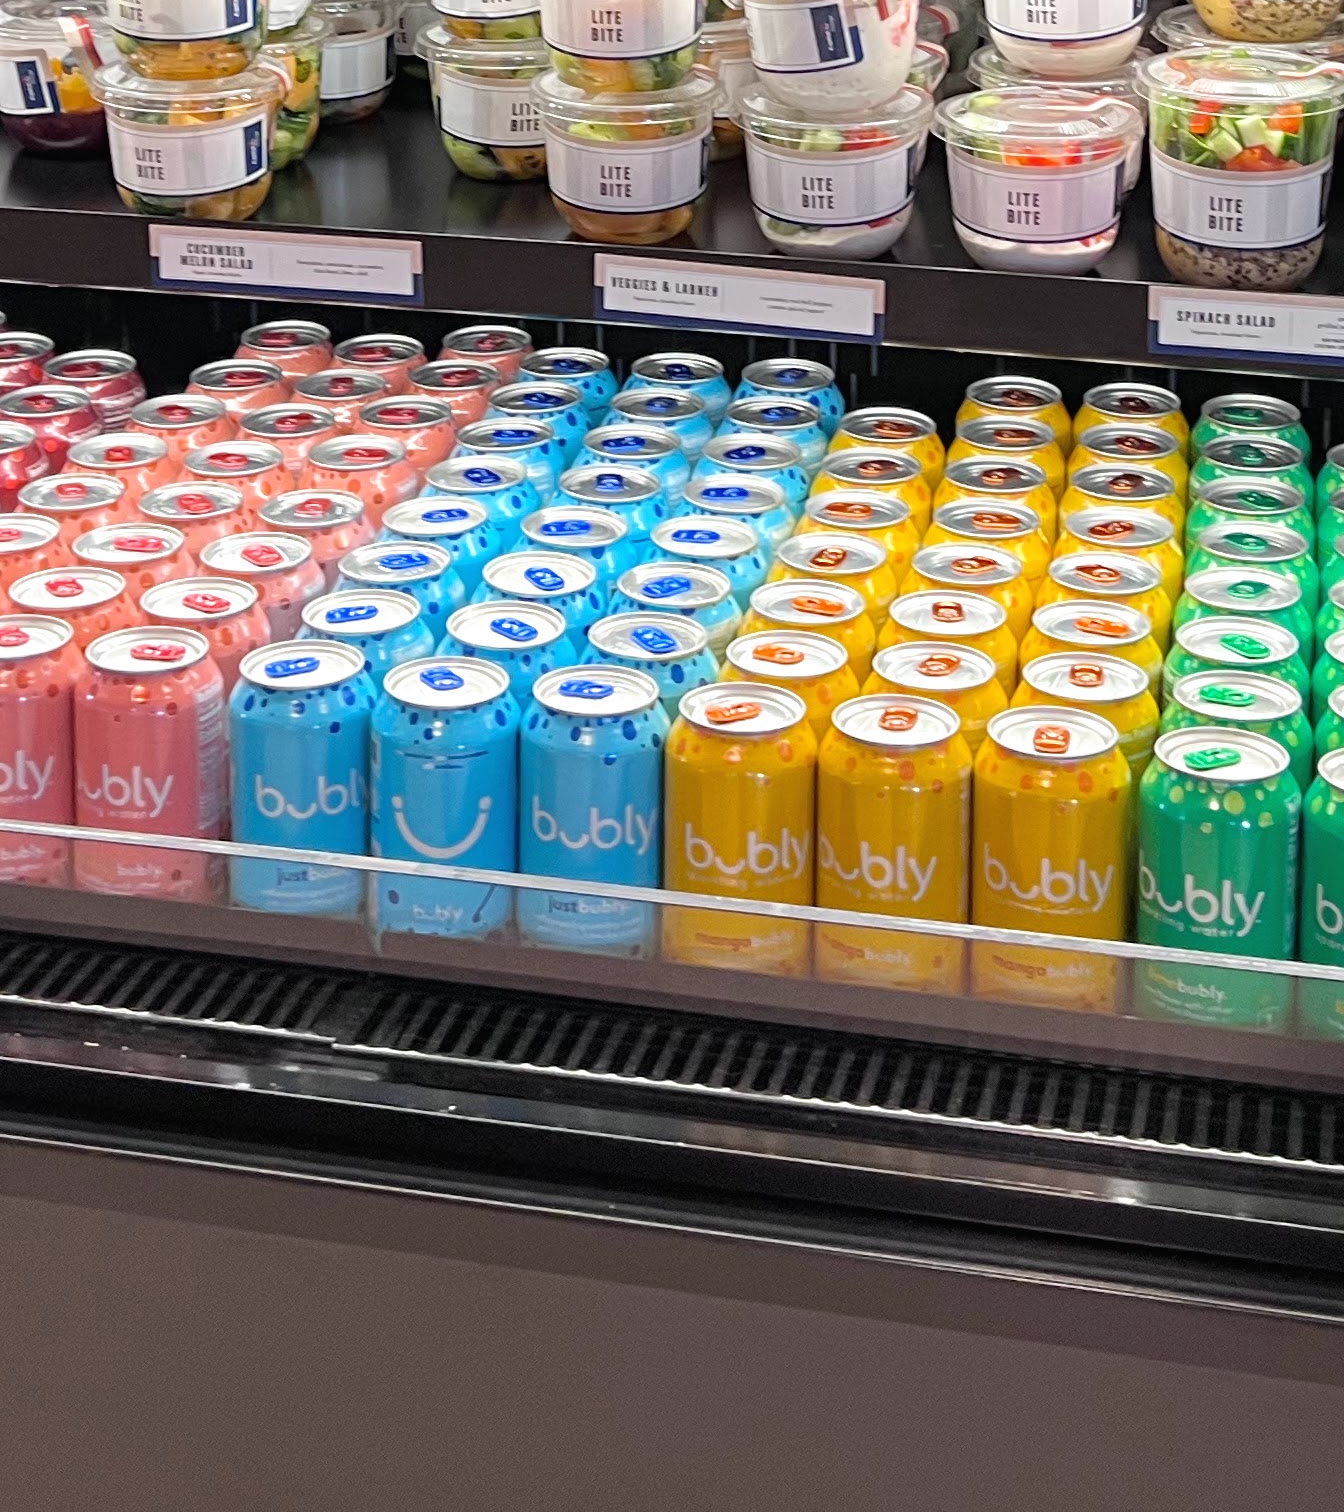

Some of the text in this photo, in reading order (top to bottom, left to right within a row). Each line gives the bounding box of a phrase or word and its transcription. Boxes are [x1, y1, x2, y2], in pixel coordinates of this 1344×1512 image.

[590, 9, 622, 25] LITE
[1026, 9, 1058, 25] BITE
[590, 26, 624, 43] BITE
[510, 118, 540, 132] BITE
[135, 147, 162, 164] LITE
[137, 164, 165, 180] BITE
[600, 165, 631, 181] LITE
[599, 182, 632, 198] BITE
[801, 176, 834, 193] LITE
[801, 193, 835, 210] BITE
[1008, 191, 1040, 208] LITE
[1209, 196, 1243, 214] LITE
[1007, 209, 1041, 226] BITE
[1209, 215, 1244, 233] BITE
[186, 243, 245, 257] CUCUMBER
[179, 255, 253, 270] MELON SALAD
[610, 275, 718, 297] VEGGIES & LABNEH
[1176, 310, 1276, 328] SPINACH SALAD
[78, 764, 174, 819] ubly
[532, 794, 658, 856] bubly
[685, 822, 810, 878] bubly
[984, 842, 1115, 913] bubly
[1139, 849, 1265, 938] bubly
